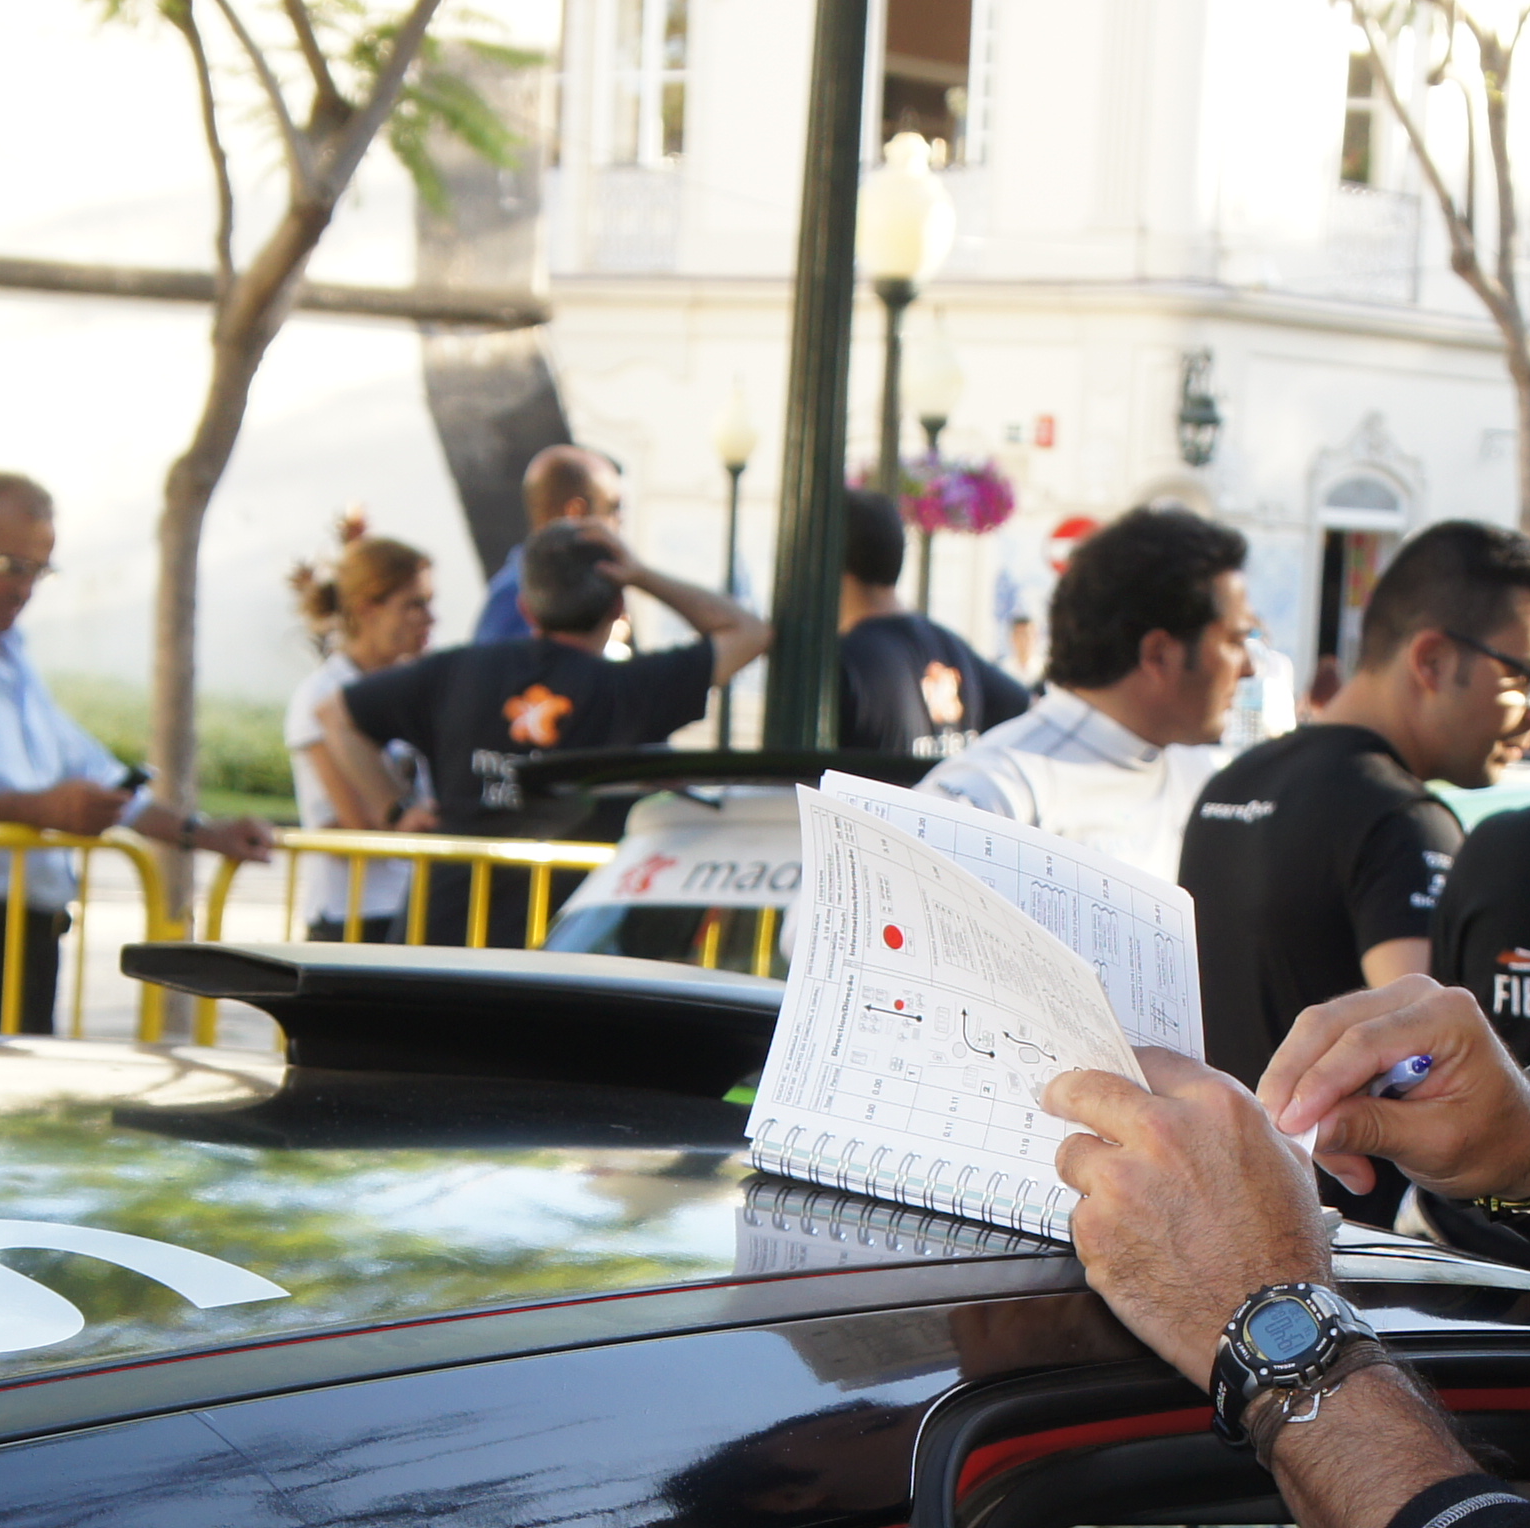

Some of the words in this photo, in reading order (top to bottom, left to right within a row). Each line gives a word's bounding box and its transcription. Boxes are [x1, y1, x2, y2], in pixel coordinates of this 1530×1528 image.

[830, 974, 855, 1057] Direction/Direção
[871, 1078, 883, 1096] 0.00
[864, 1103, 877, 1121] 0.00
[948, 1096, 959, 1113] 0.11
[942, 1121, 954, 1138] 0.11
[1019, 1138, 1030, 1156] 0.19
